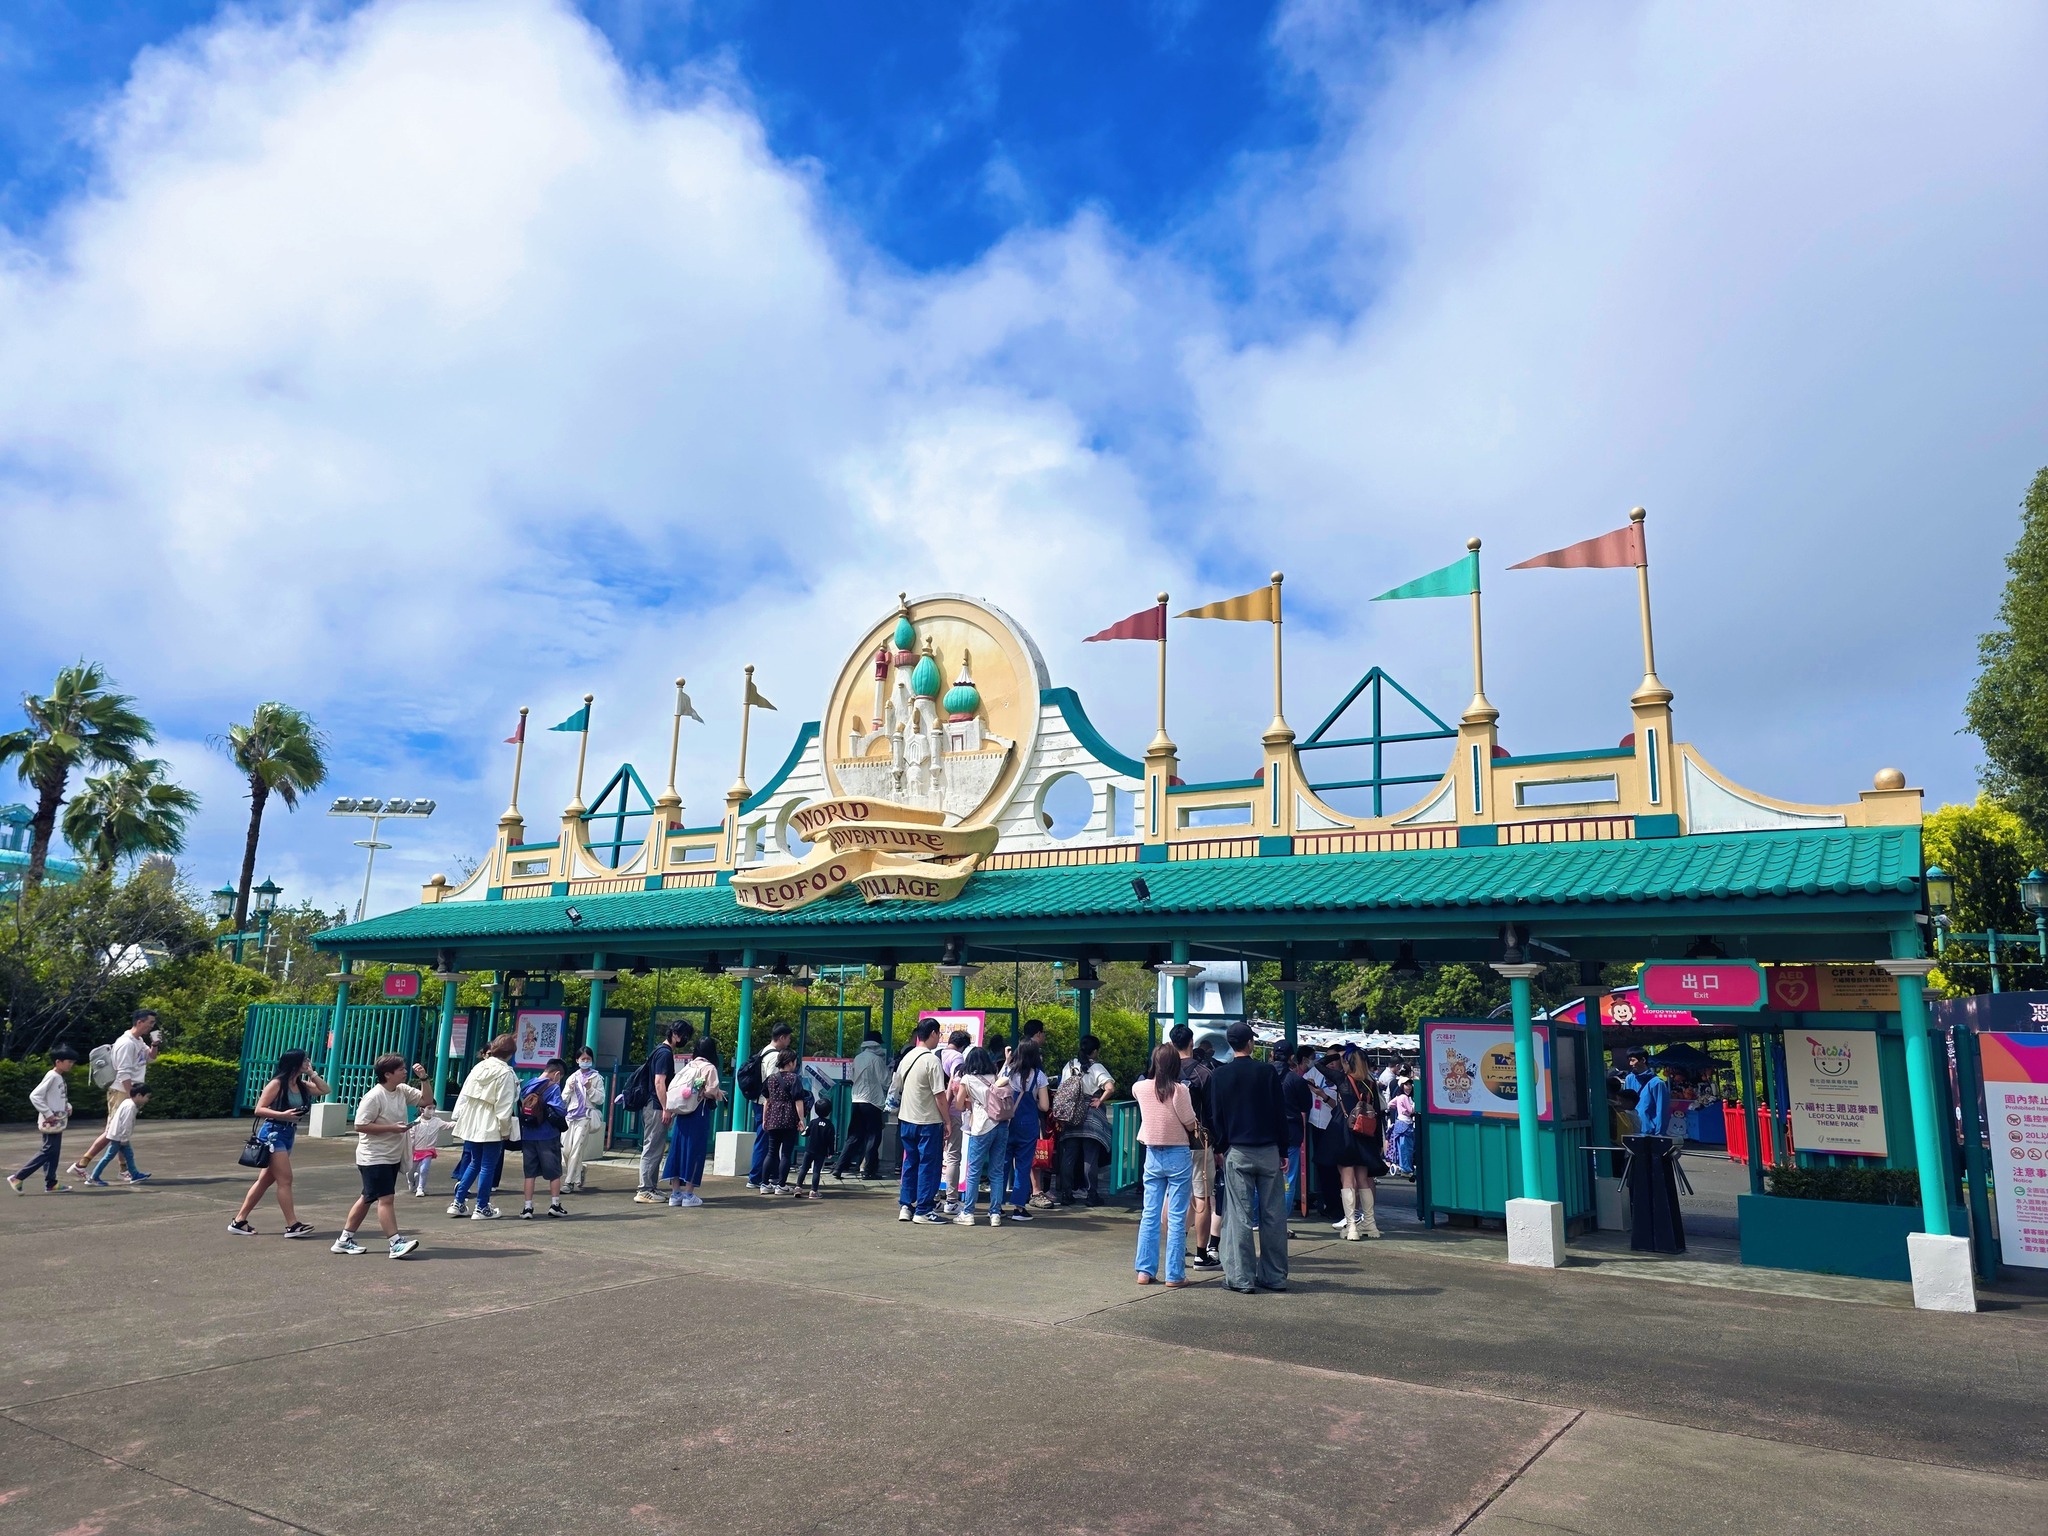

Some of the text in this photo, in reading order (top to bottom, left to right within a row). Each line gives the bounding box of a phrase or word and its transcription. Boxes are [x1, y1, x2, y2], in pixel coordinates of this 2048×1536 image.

[795, 802, 869, 832] WORLD
[828, 829, 944, 851] ADVENTURE
[738, 864, 940, 908] AT LEOFOO VILLAGE
[1779, 971, 1804, 979] AED
[1831, 968, 1855, 977] CPR
[1682, 973, 1719, 990] 出口
[1795, 1102, 1879, 1115] 六福村主題遊樂園
